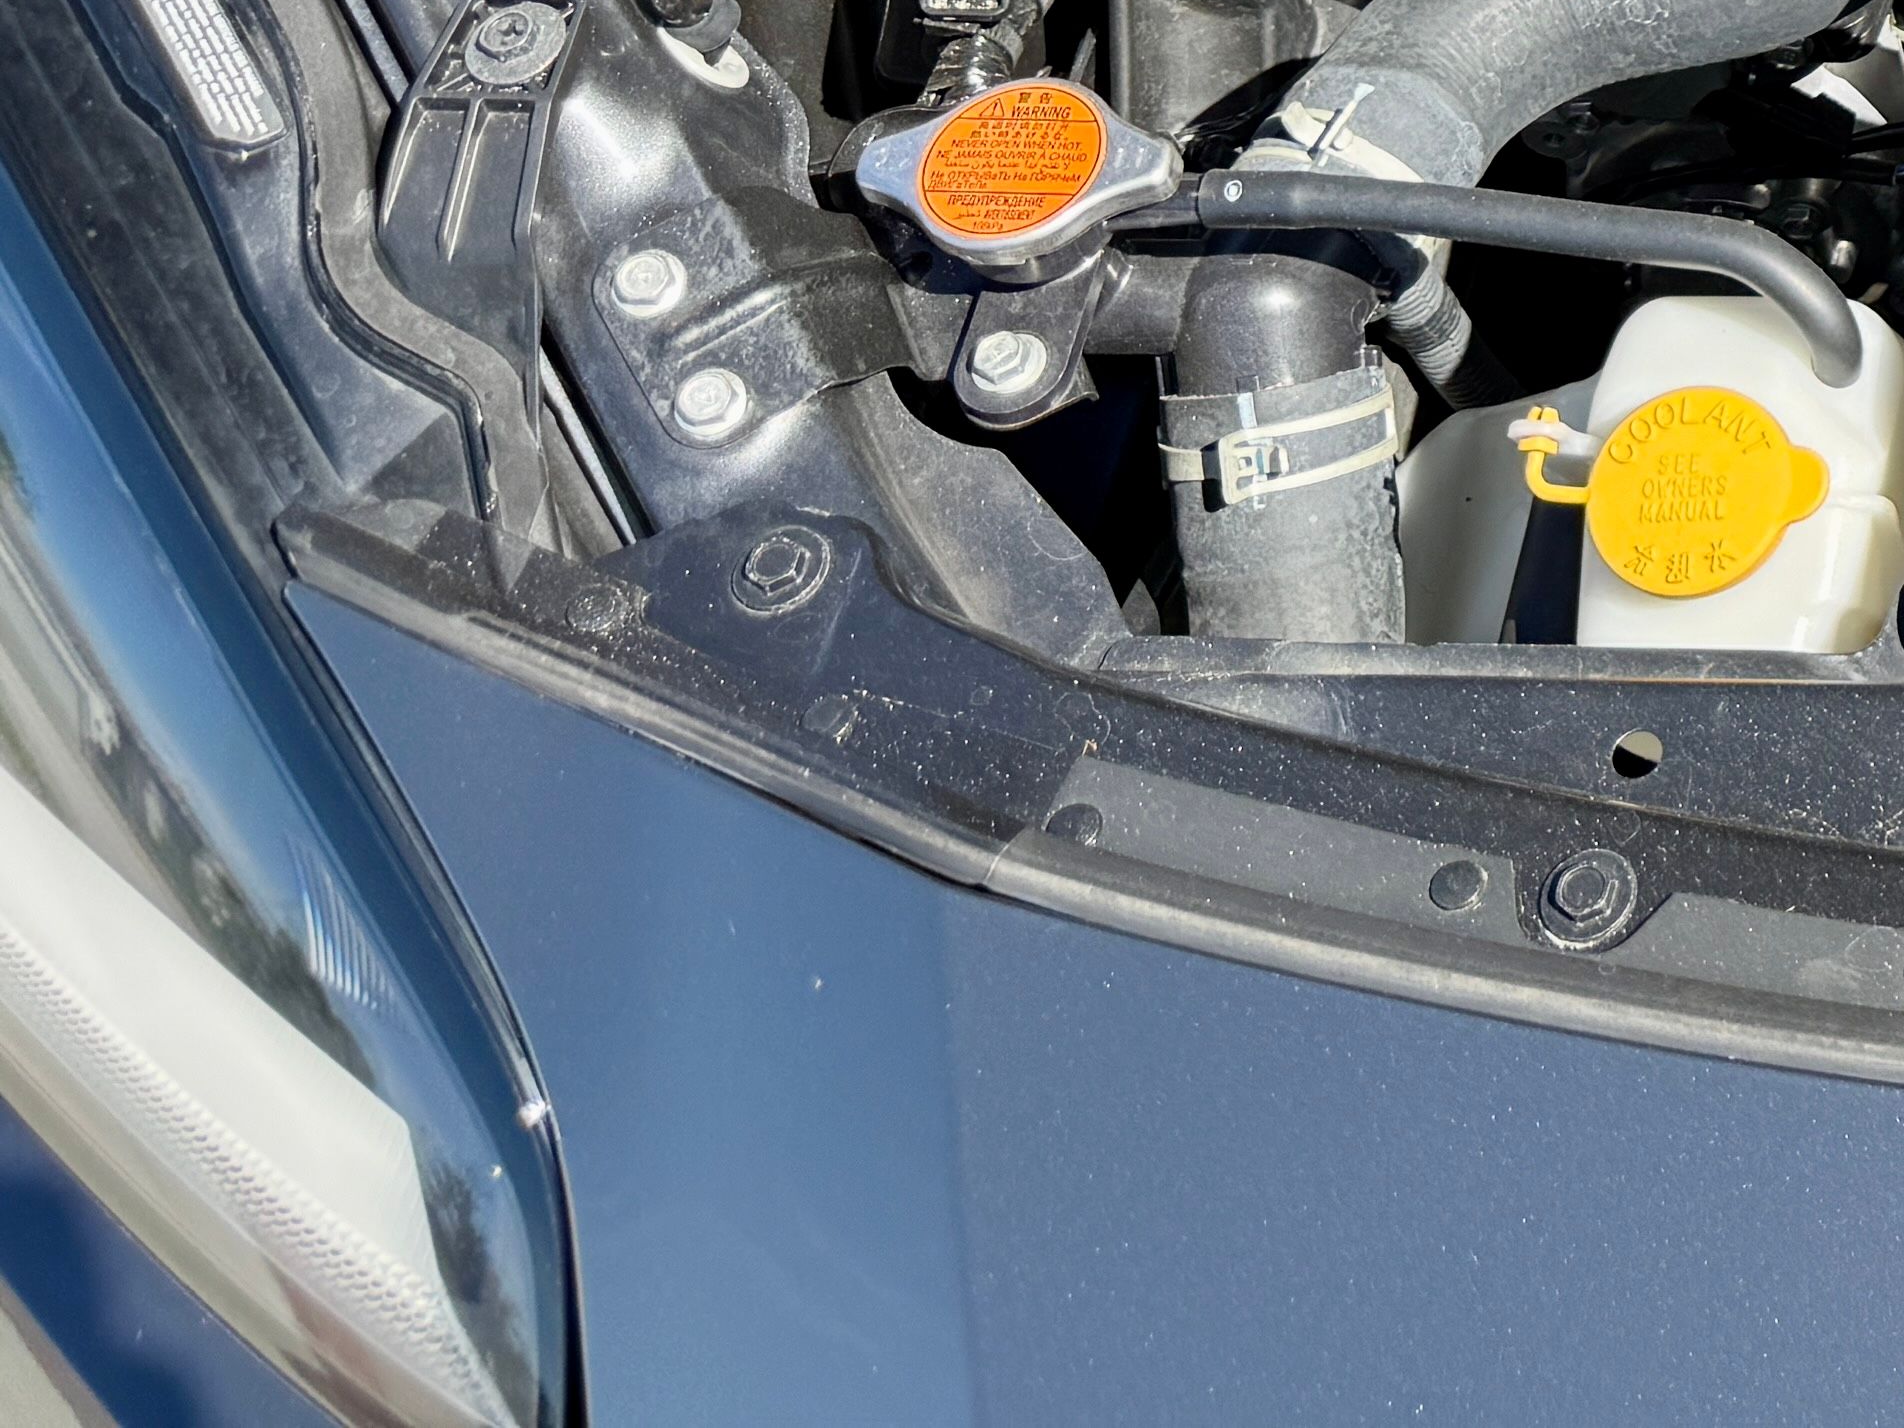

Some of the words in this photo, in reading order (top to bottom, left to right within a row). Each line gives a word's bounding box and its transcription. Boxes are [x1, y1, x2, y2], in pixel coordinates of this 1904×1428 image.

[1012, 106, 1072, 119] WARNING
[951, 139, 987, 148] NEVER
[990, 140, 1019, 149] OPEN
[1024, 141, 1055, 150] WHEN
[936, 151, 951, 159] NE
[954, 151, 992, 159] JAMAIS
[995, 150, 1035, 159] OUVRIR
[948, 194, 1046, 208] ПРЕДУПРЕЖДЕНИЕ
[1608, 396, 1772, 465] COOLANT
[1657, 454, 1700, 475] SEE
[1641, 475, 1728, 499] OWNERS
[1639, 499, 1724, 524] MANUAL
